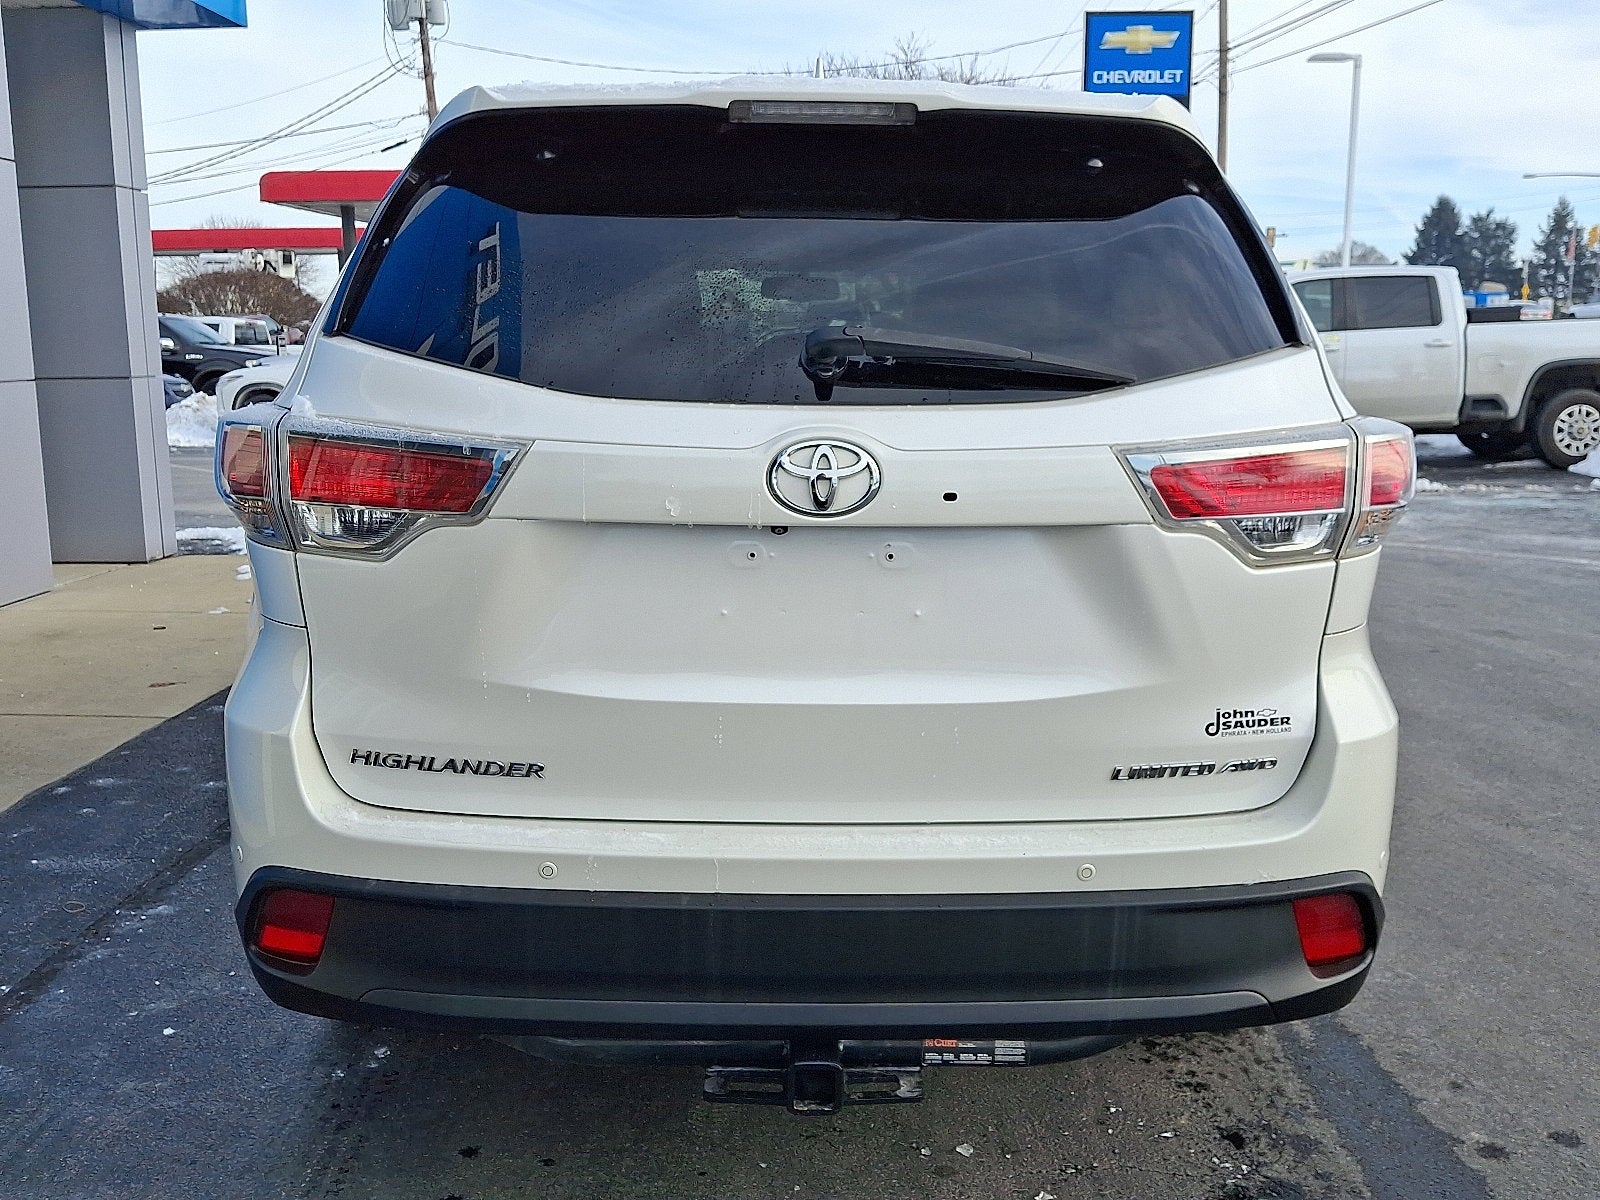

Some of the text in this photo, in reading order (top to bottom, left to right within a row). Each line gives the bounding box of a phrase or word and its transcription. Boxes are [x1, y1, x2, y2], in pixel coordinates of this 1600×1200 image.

[1092, 69, 1183, 84] CHEVROLET
[1221, 716, 1292, 731] SAUDER
[1221, 730, 1247, 738] EPHRATA
[1266, 726, 1292, 735] HOLLAND
[350, 748, 546, 779] HIGHLANDER
[1111, 760, 1216, 781] LIMITED
